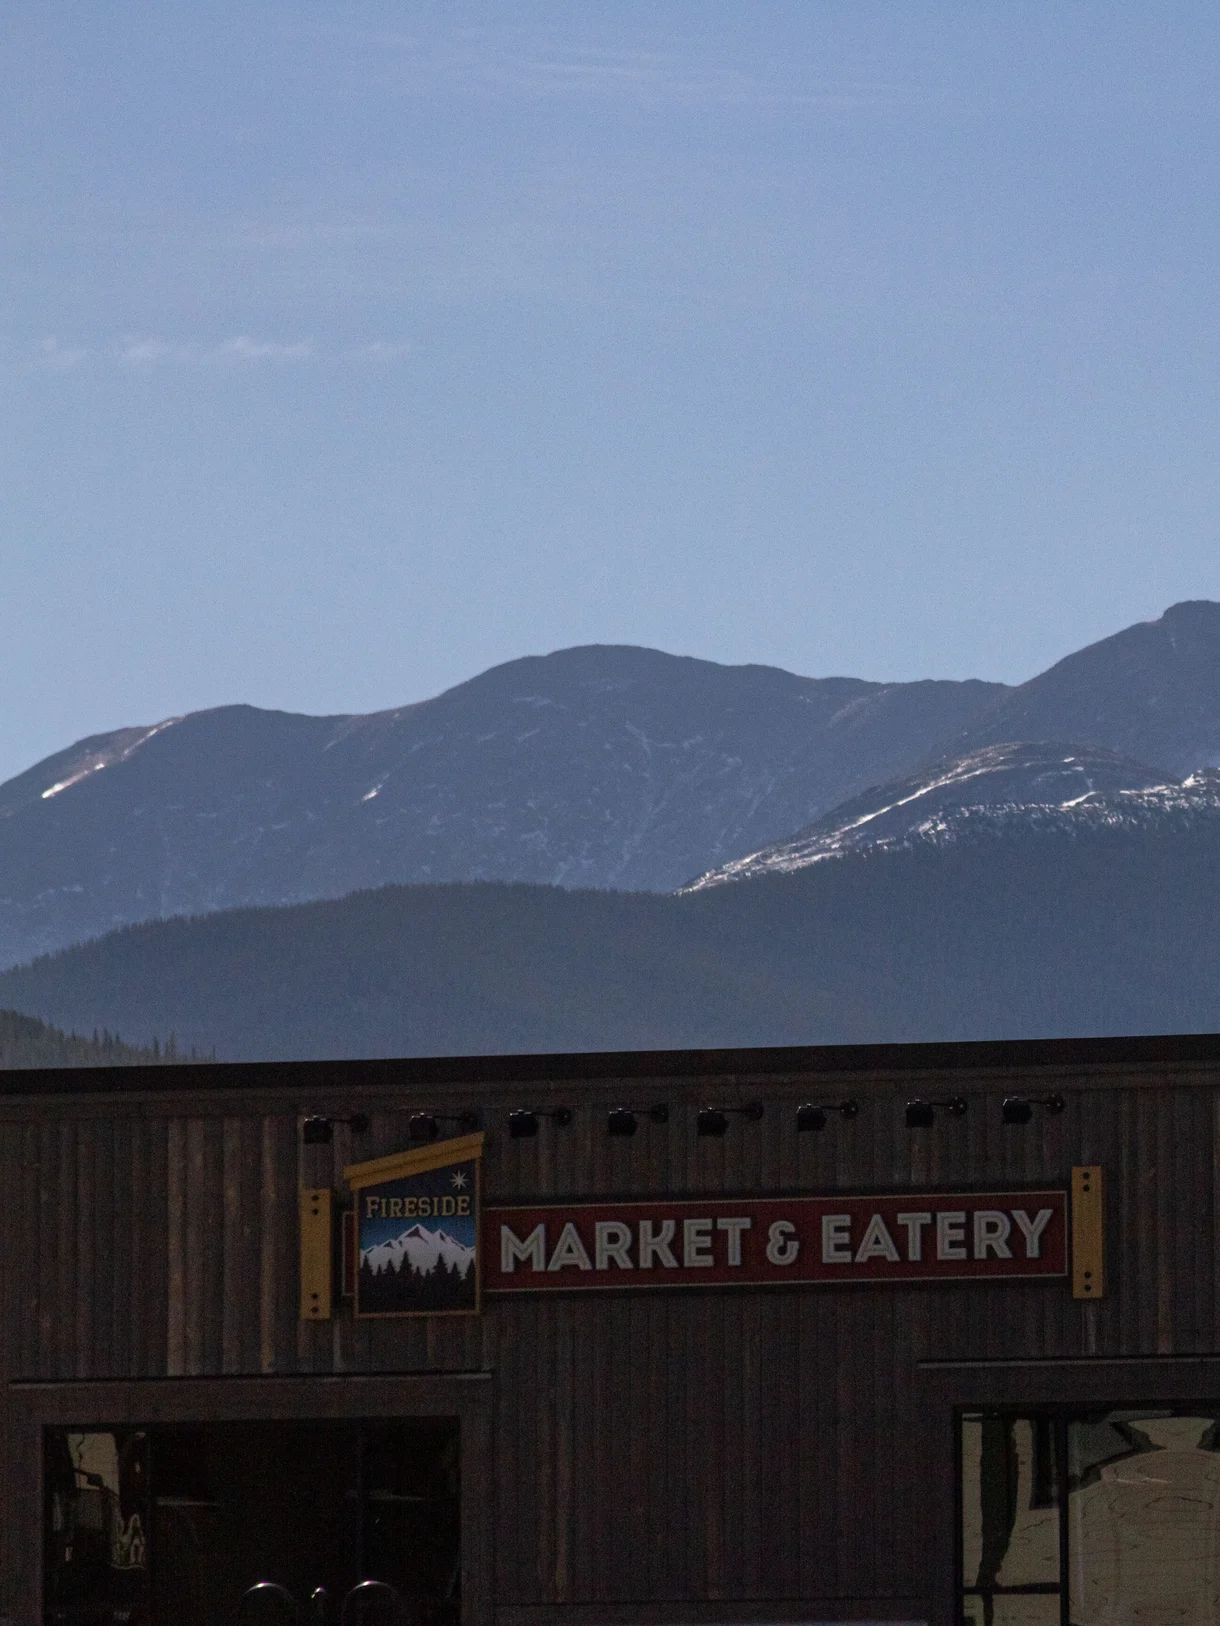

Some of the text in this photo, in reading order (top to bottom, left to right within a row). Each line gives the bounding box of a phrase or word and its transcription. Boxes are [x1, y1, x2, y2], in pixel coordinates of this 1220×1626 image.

[366, 1196, 470, 1218] FIRESIDE
[500, 1209, 1054, 1273] MARKET & EATERY
